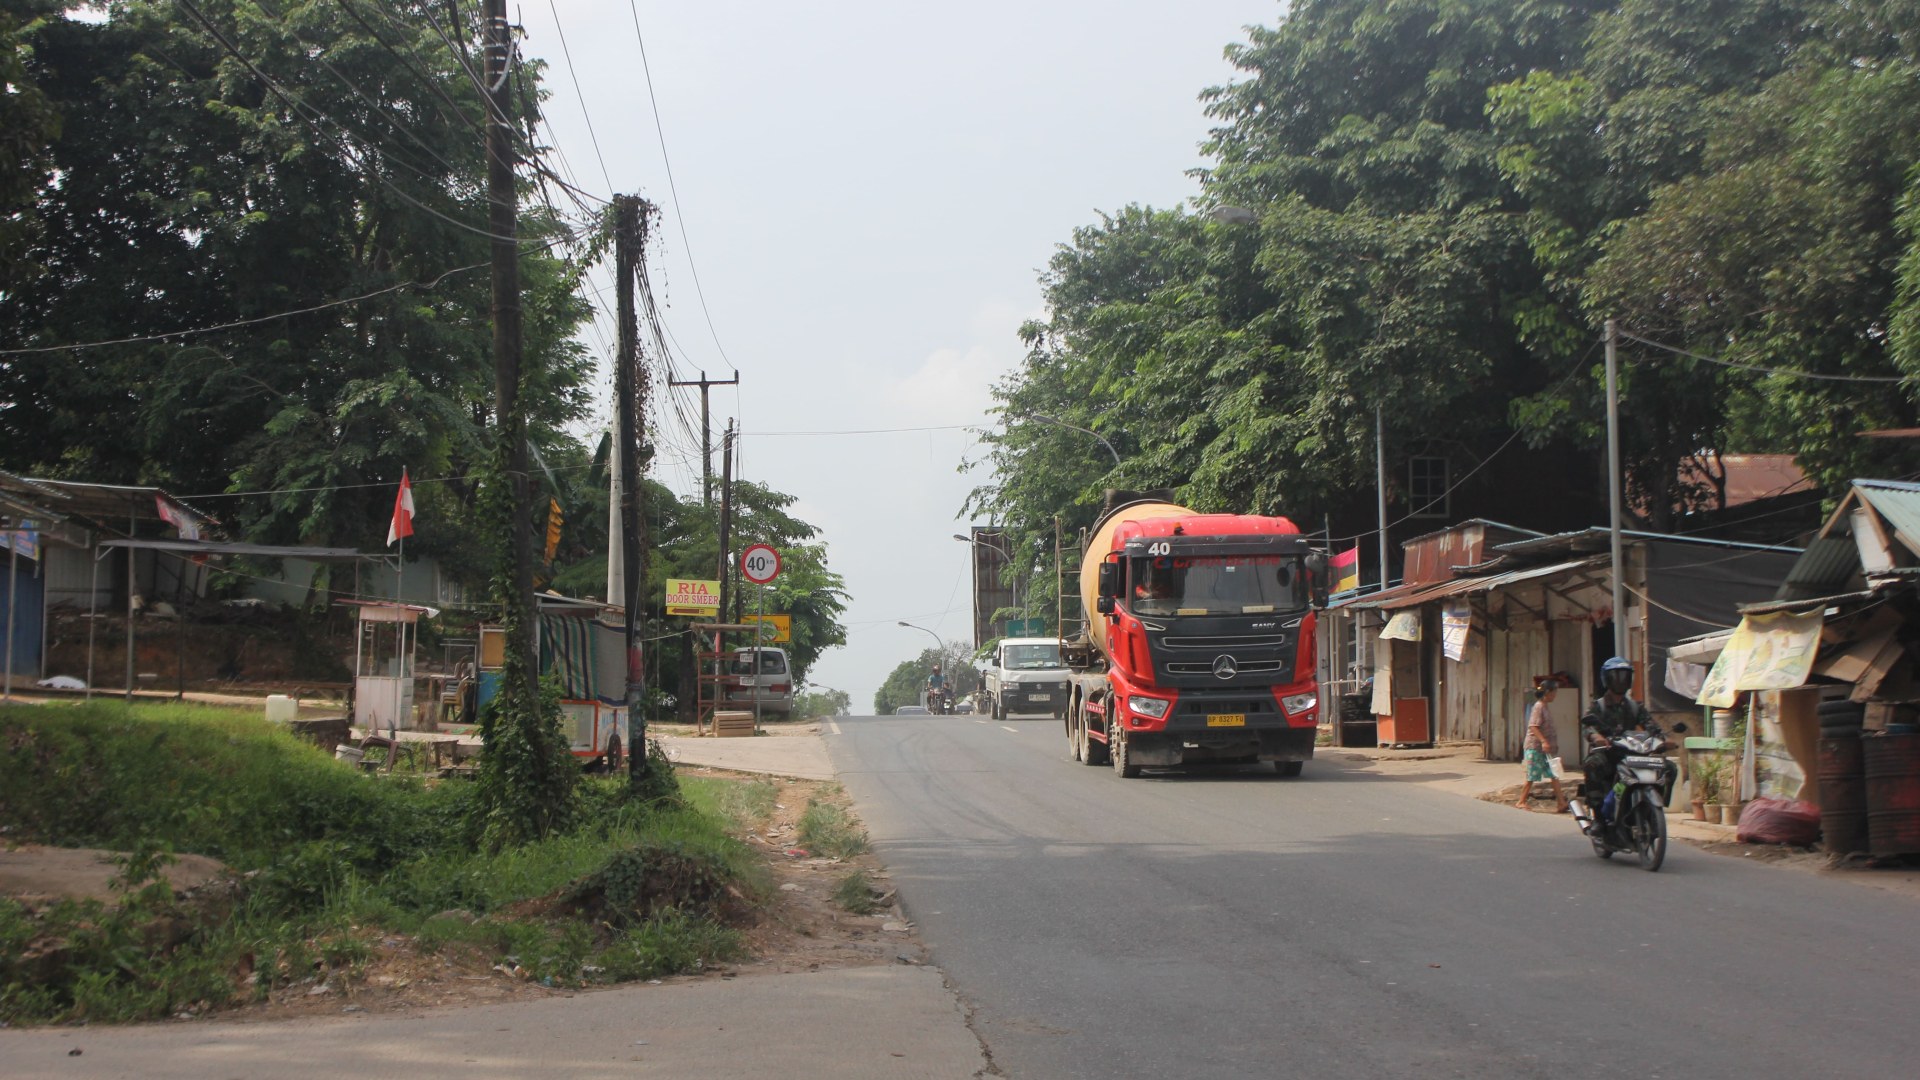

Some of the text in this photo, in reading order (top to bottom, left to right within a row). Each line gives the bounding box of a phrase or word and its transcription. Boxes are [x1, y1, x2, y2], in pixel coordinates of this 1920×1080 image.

[1148, 542, 1171, 556] 40
[747, 556, 766, 571] 40
[677, 582, 709, 595] RIA
[666, 594, 719, 605] DOOR SMEER
